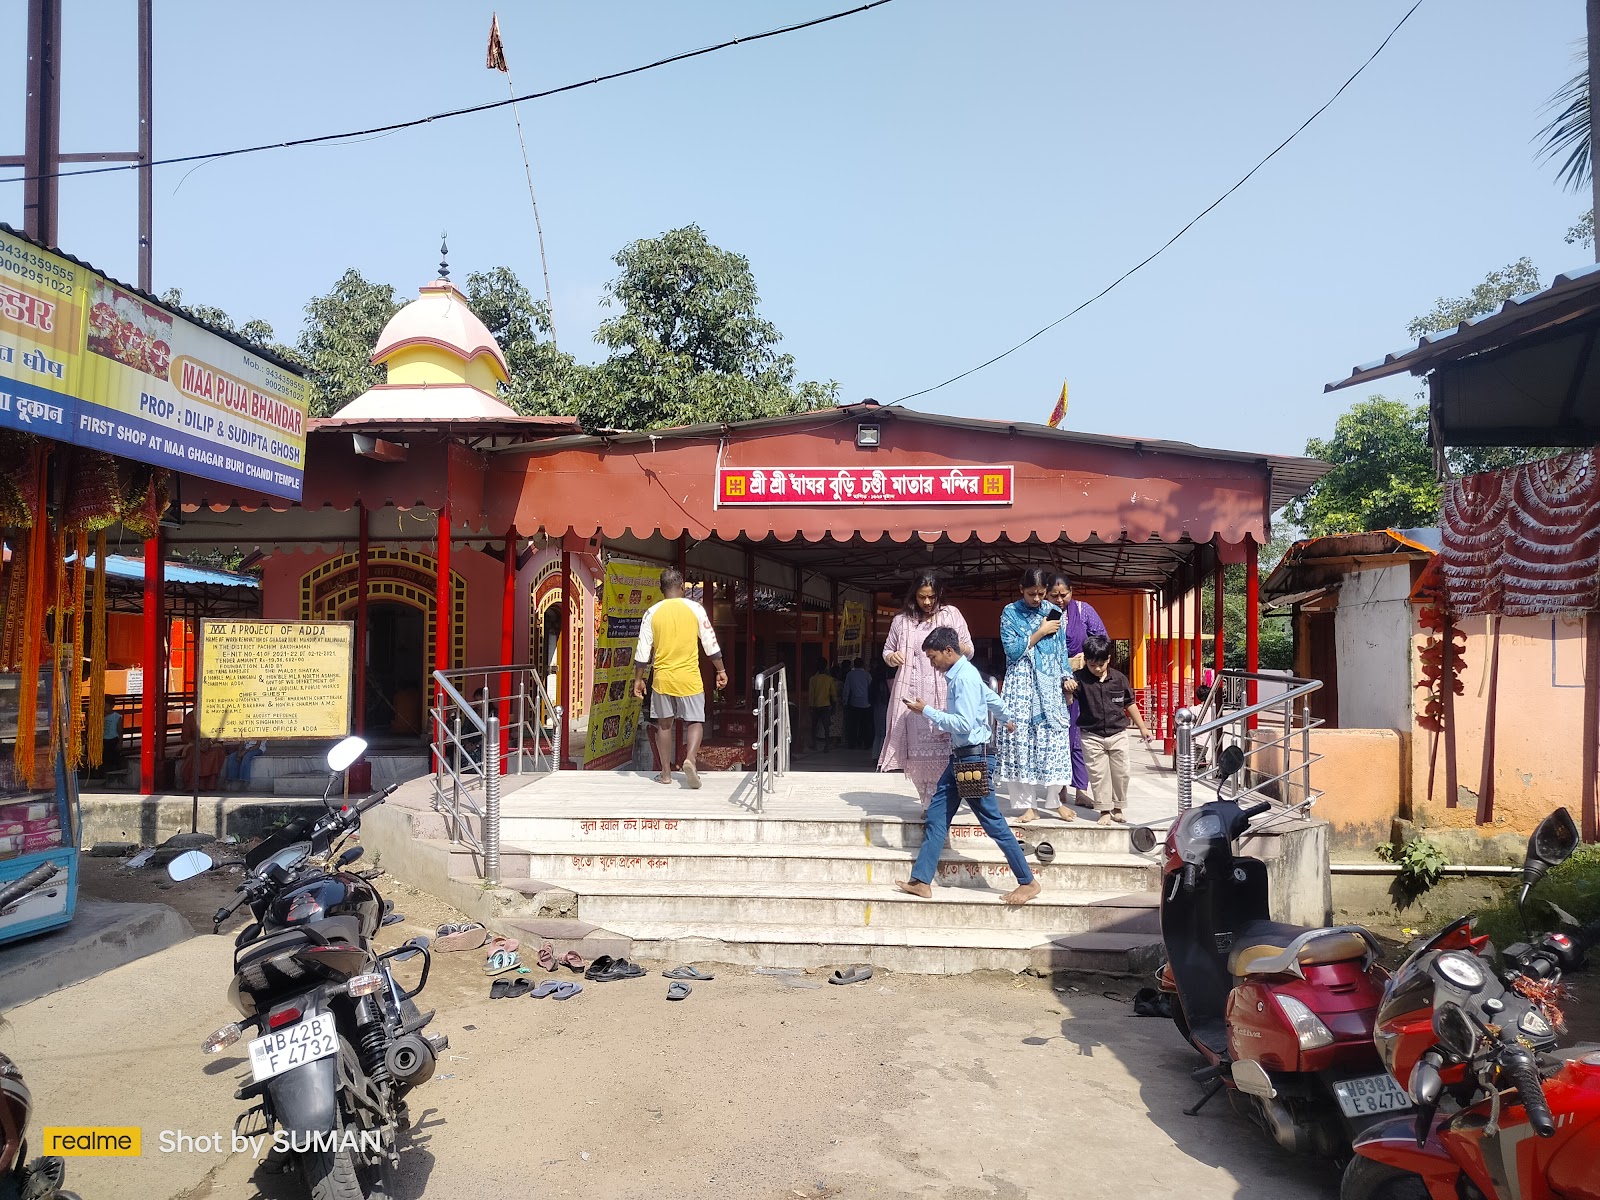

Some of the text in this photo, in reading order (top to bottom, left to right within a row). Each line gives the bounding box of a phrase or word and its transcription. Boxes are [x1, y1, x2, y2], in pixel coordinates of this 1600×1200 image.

[22, 349, 64, 379] घोष
[243, 356, 264, 373] Mob.:
[182, 362, 302, 435] MAA PUJA BHANDAR
[265, 378, 304, 403] 9002951022
[16, 396, 64, 424] दूकान
[140, 392, 174, 420] PROP
[184, 409, 214, 433] DILIP
[217, 420, 224, 437] &
[228, 424, 268, 453] SUDIPTA
[270, 440, 300, 463] GHOSH
[80, 414, 300, 490] FIRST SHOP AT MAA GHAGAR BURI CHANDI TEMPLE
[749, 470, 767, 495] শ্রী
[769, 470, 787, 495] শ্রী
[828, 469, 856, 501] বুড়ি
[890, 474, 934, 495] মাতার
[939, 469, 980, 494] মন্দির
[231, 625, 326, 635] A PROJECT OF ADDA
[258, 674, 265, 684] &
[267, 700, 274, 708] &
[623, 820, 637, 831] कर
[263, 1020, 323, 1055] WB42B
[1232, 1025, 1262, 1039] Activa
[269, 1034, 335, 1073] F 4732
[1345, 1075, 1397, 1097] WB38A
[1366, 1091, 1407, 1111] 8470
